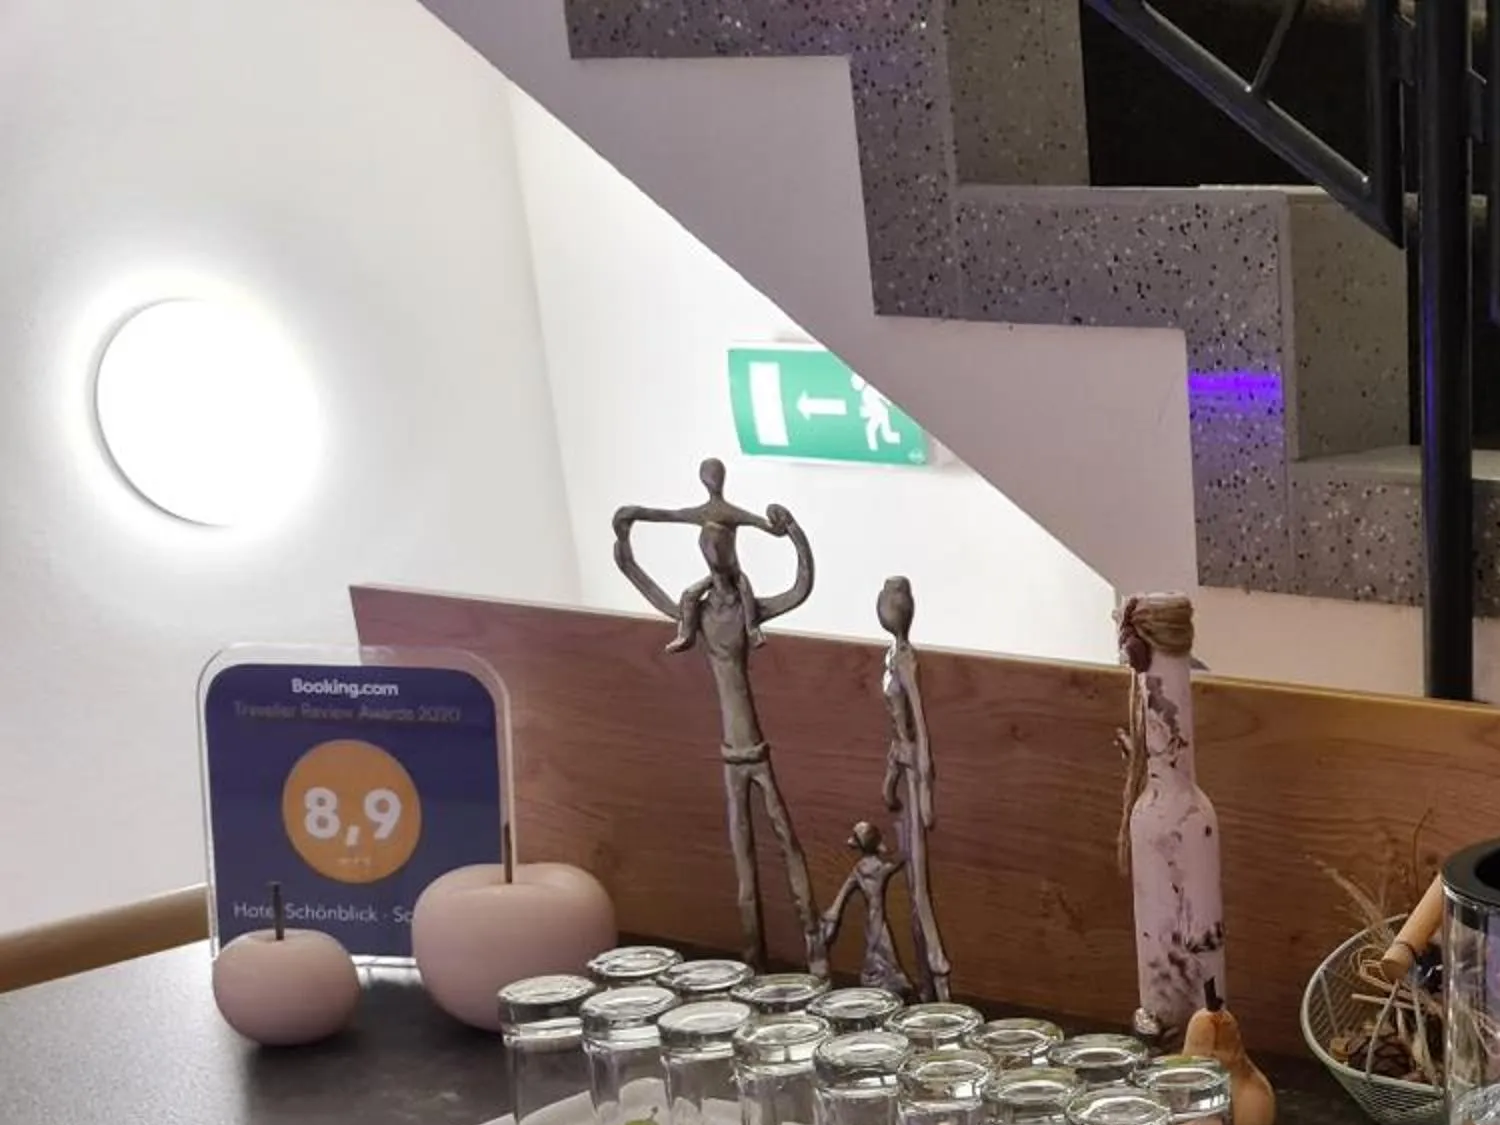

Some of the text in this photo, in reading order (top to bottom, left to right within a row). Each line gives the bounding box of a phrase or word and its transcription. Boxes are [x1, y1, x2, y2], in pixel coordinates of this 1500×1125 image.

[291, 678, 399, 699] Booking.com
[303, 786, 403, 847] 8,9
[234, 903, 280, 921] Hote
[285, 902, 378, 922] Schönblick
